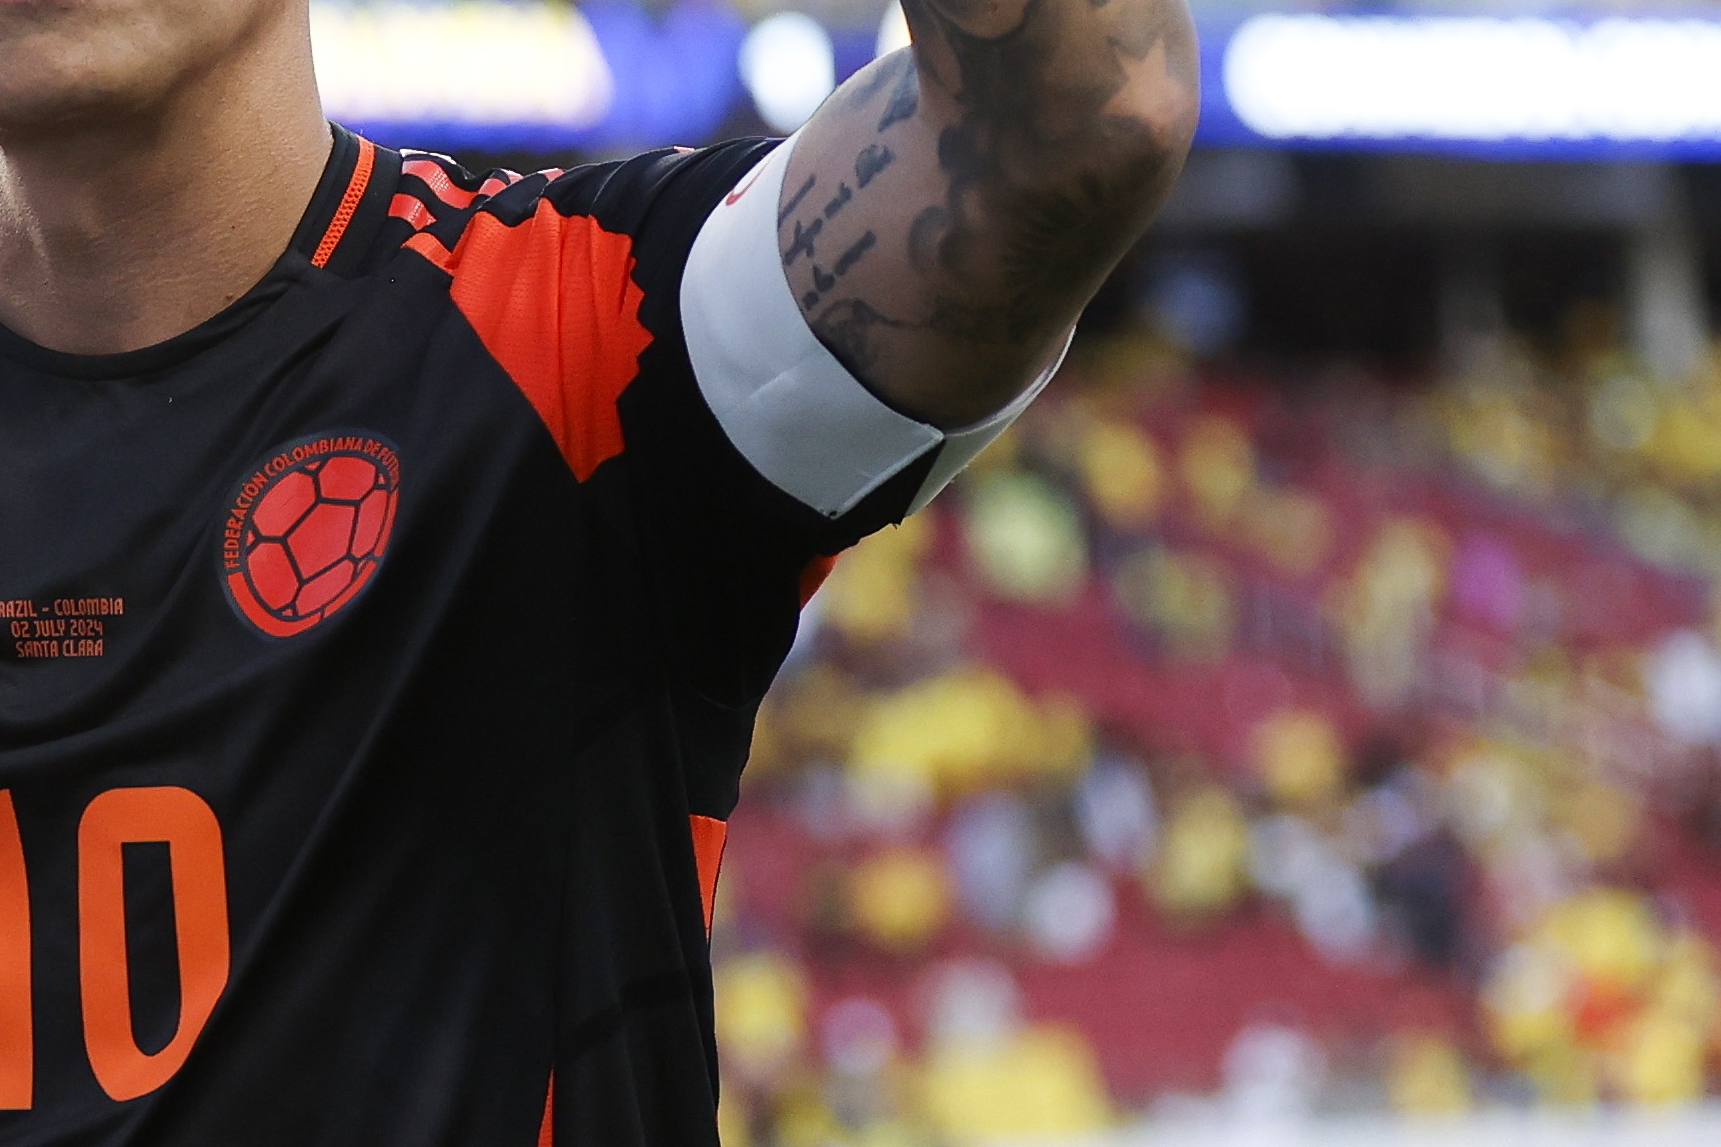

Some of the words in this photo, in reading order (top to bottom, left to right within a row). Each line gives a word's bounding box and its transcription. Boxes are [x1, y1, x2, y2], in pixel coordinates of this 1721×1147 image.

[264, 437, 364, 477] COLOMBIANA
[54, 597, 124, 616] COLOMBIA
[10, 621, 31, 638] 02
[34, 619, 66, 638] JULY
[70, 619, 104, 636] 2024
[15, 640, 59, 658] SANTA
[62, 639, 104, 657] CLARA
